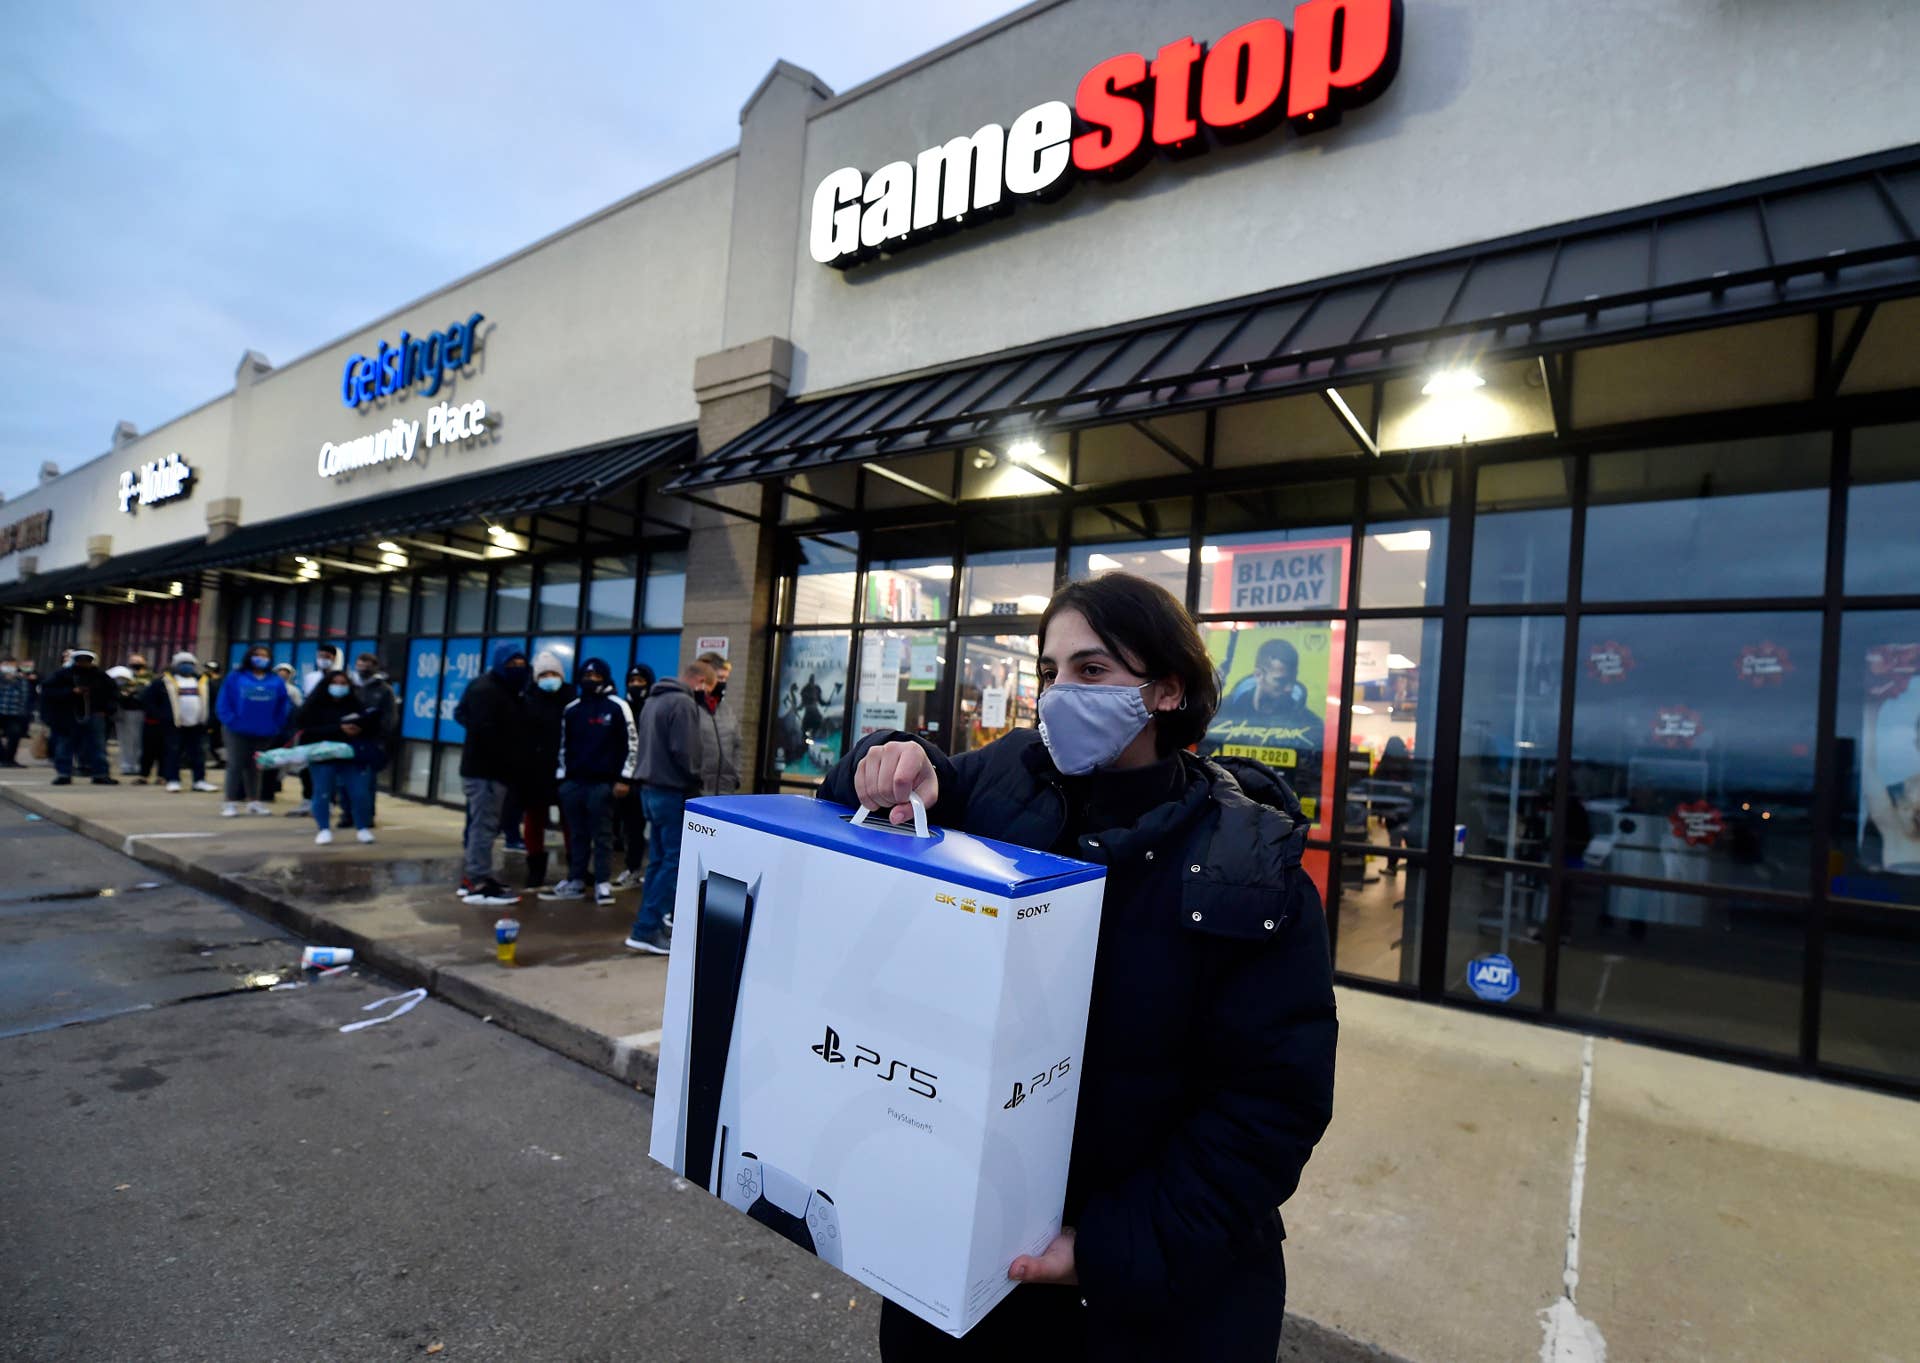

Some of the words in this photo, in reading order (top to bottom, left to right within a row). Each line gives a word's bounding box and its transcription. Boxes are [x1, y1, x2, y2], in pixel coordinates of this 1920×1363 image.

[810, 0, 1392, 263] GameStop
[341, 313, 486, 409] Geisinger
[318, 418, 419, 478] Community
[426, 400, 486, 448] Place
[1237, 554, 1325, 584] BLACK
[1236, 580, 1324, 608] FRIDAY
[688, 821, 717, 837] SONY
[935, 893, 957, 906] 8K
[1016, 903, 1050, 920] SONY
[1475, 965, 1512, 985] ADT
[854, 1044, 938, 1099] PS5
[1030, 1056, 1071, 1094] PS5
